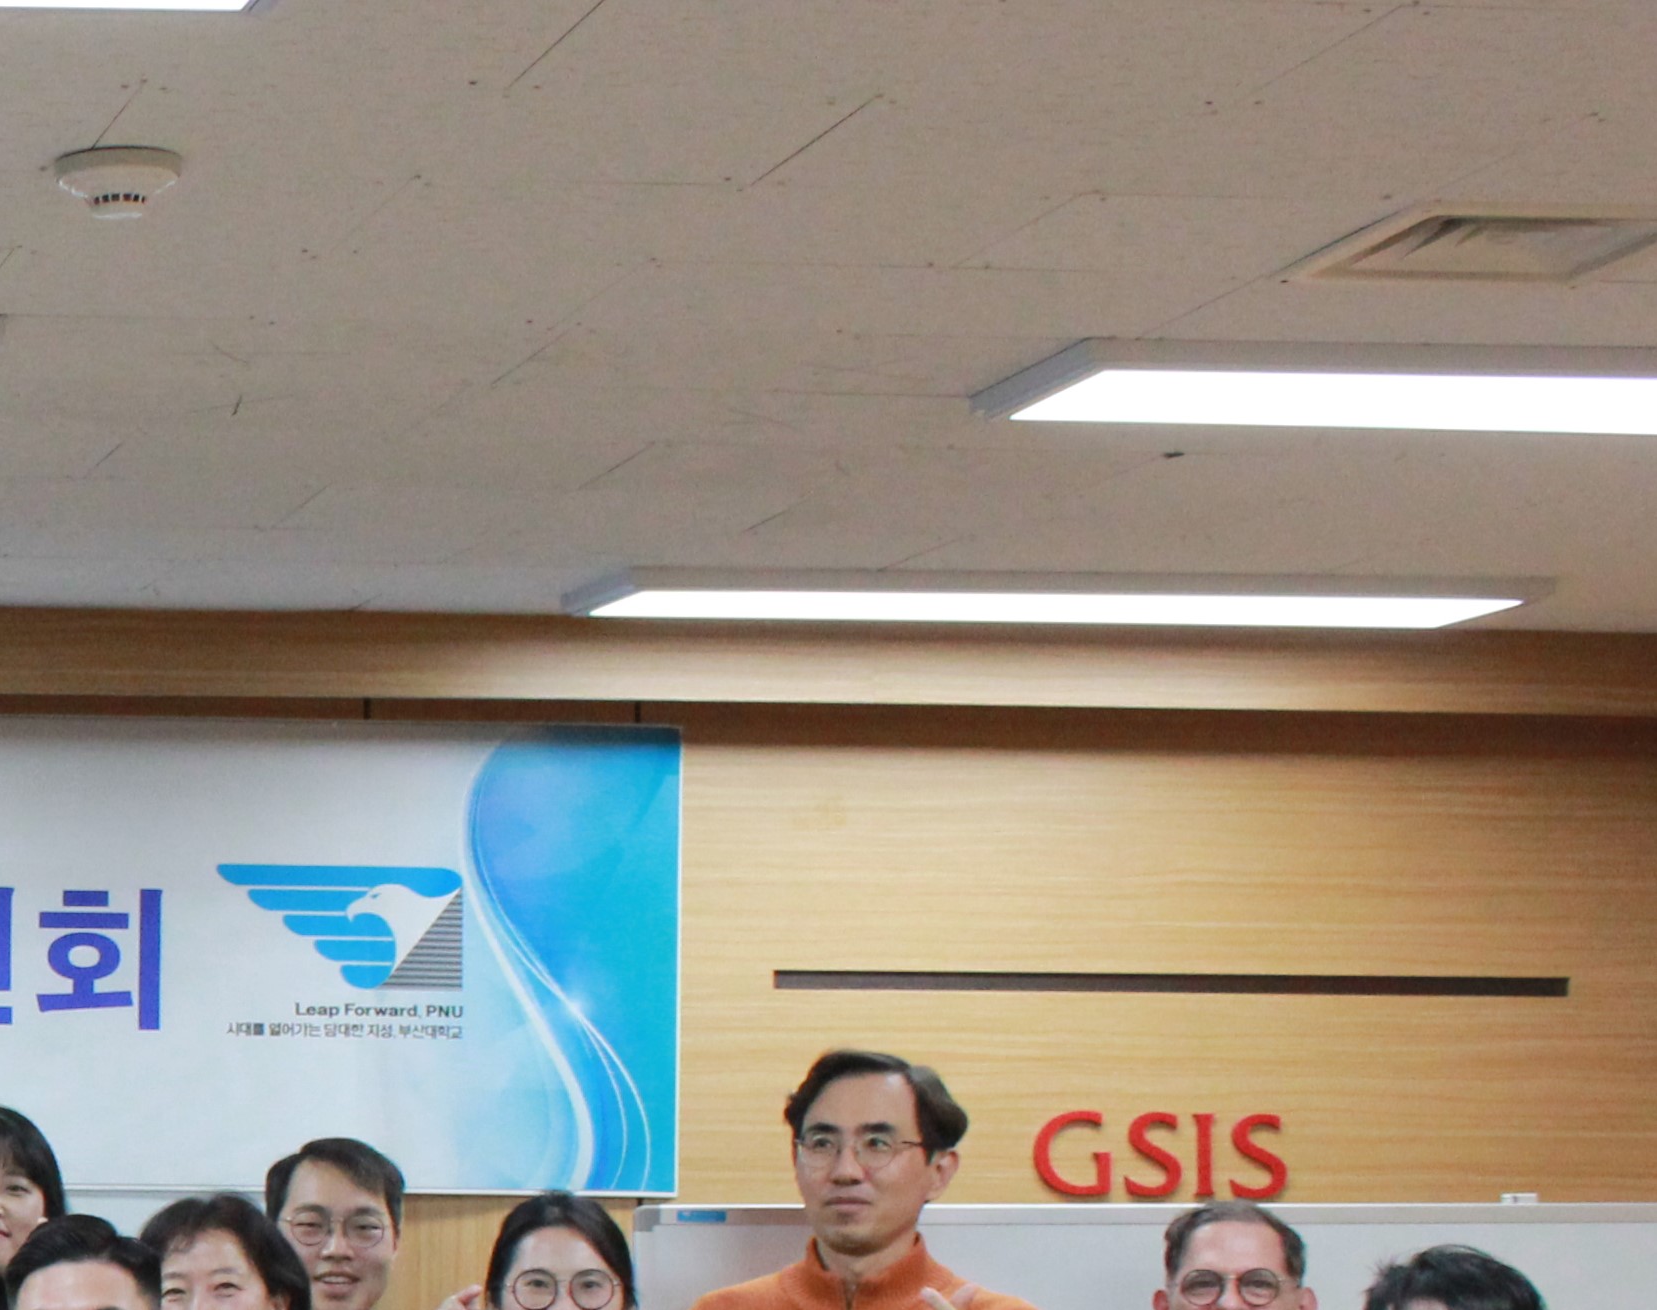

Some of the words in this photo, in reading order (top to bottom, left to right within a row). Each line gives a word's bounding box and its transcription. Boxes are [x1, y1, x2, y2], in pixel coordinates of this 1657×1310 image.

[294, 1002, 341, 1018] Leap
[426, 1004, 465, 1019] PNU
[1032, 1110, 1288, 1201] GSIS
